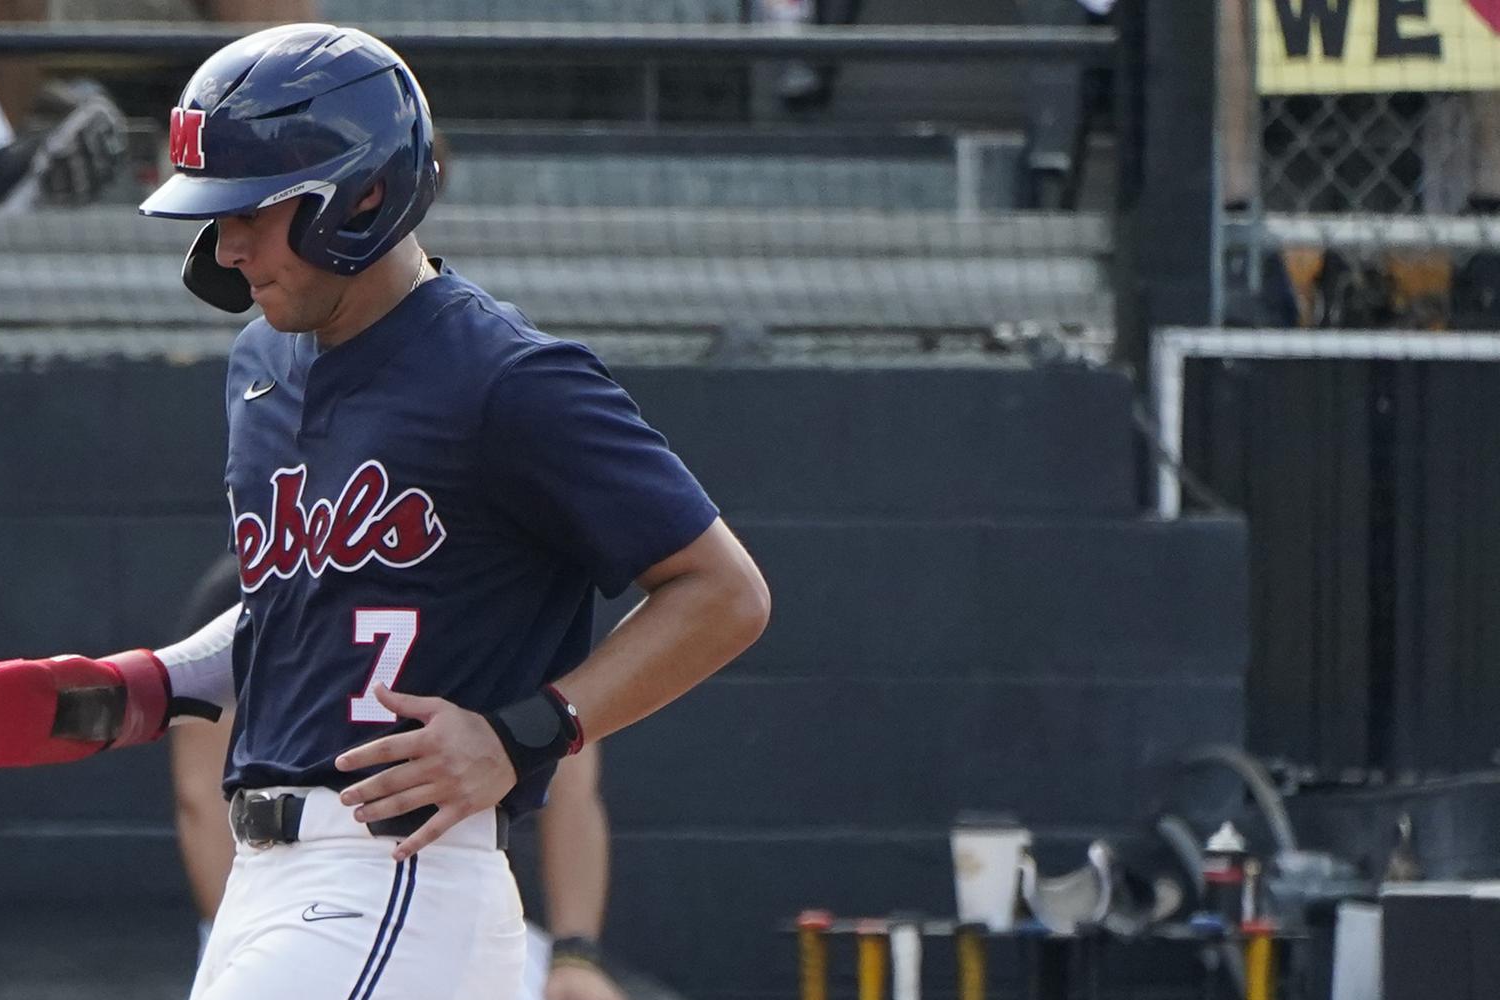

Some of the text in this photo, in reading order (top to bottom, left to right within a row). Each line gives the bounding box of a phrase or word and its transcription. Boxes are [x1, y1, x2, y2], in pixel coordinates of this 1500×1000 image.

[1273, 0, 1442, 59] WE
[170, 106, 206, 169] M
[232, 459, 447, 593] ebels
[349, 607, 420, 723] 7
